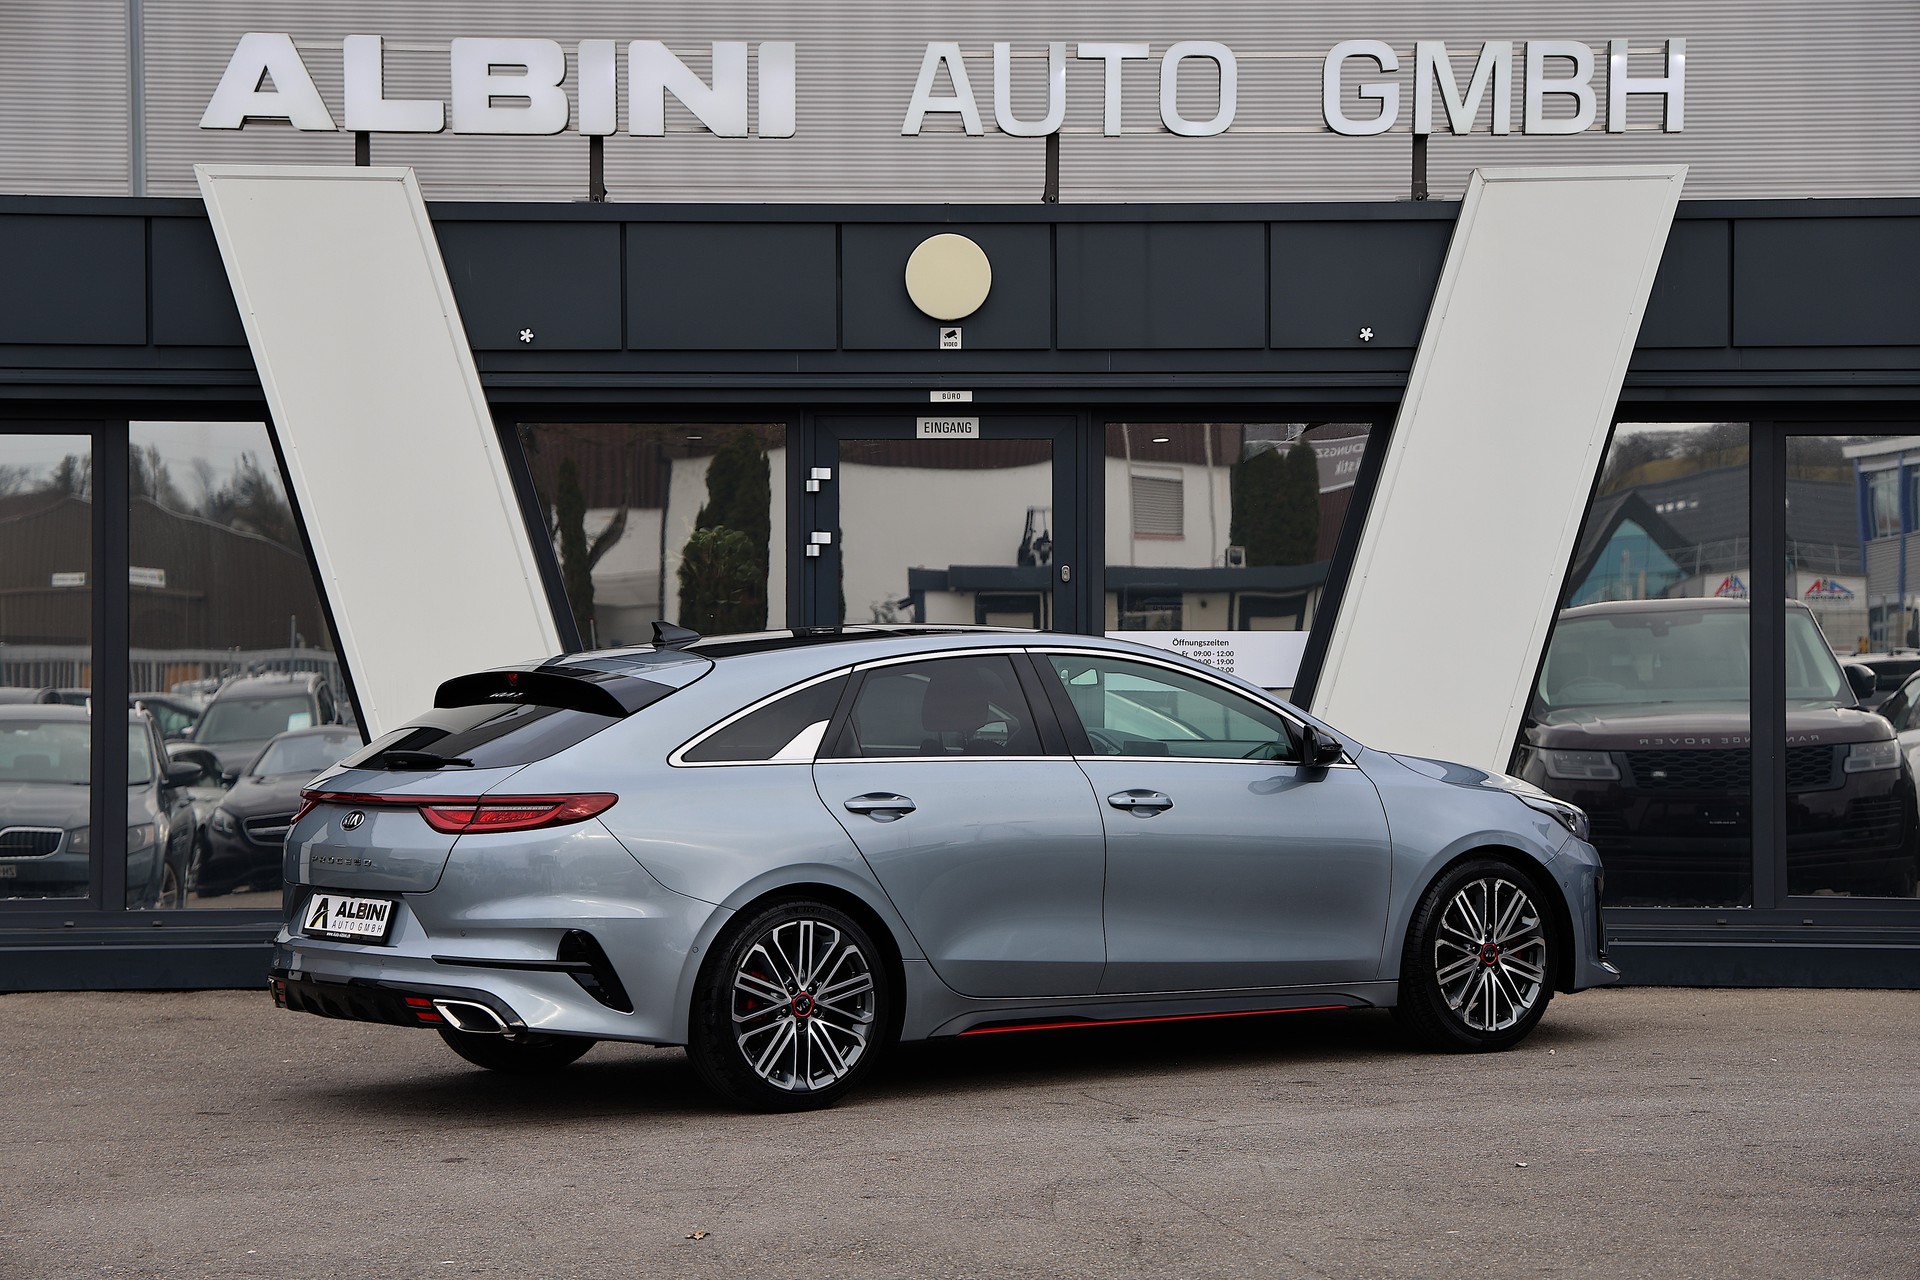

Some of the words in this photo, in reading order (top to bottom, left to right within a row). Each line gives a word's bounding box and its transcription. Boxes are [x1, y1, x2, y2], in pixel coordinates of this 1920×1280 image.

[199, 32, 797, 138] ALBINI
[901, 41, 1239, 138] AUTO
[1321, 38, 1688, 137] GMBH
[942, 392, 961, 400] BÜRO
[924, 421, 972, 434] EINGANG
[1172, 637, 1230, 648] Öffnungszeiten
[335, 901, 388, 922] ALBINI
[331, 920, 355, 931] AUTO
[357, 921, 383, 933] GMBH
